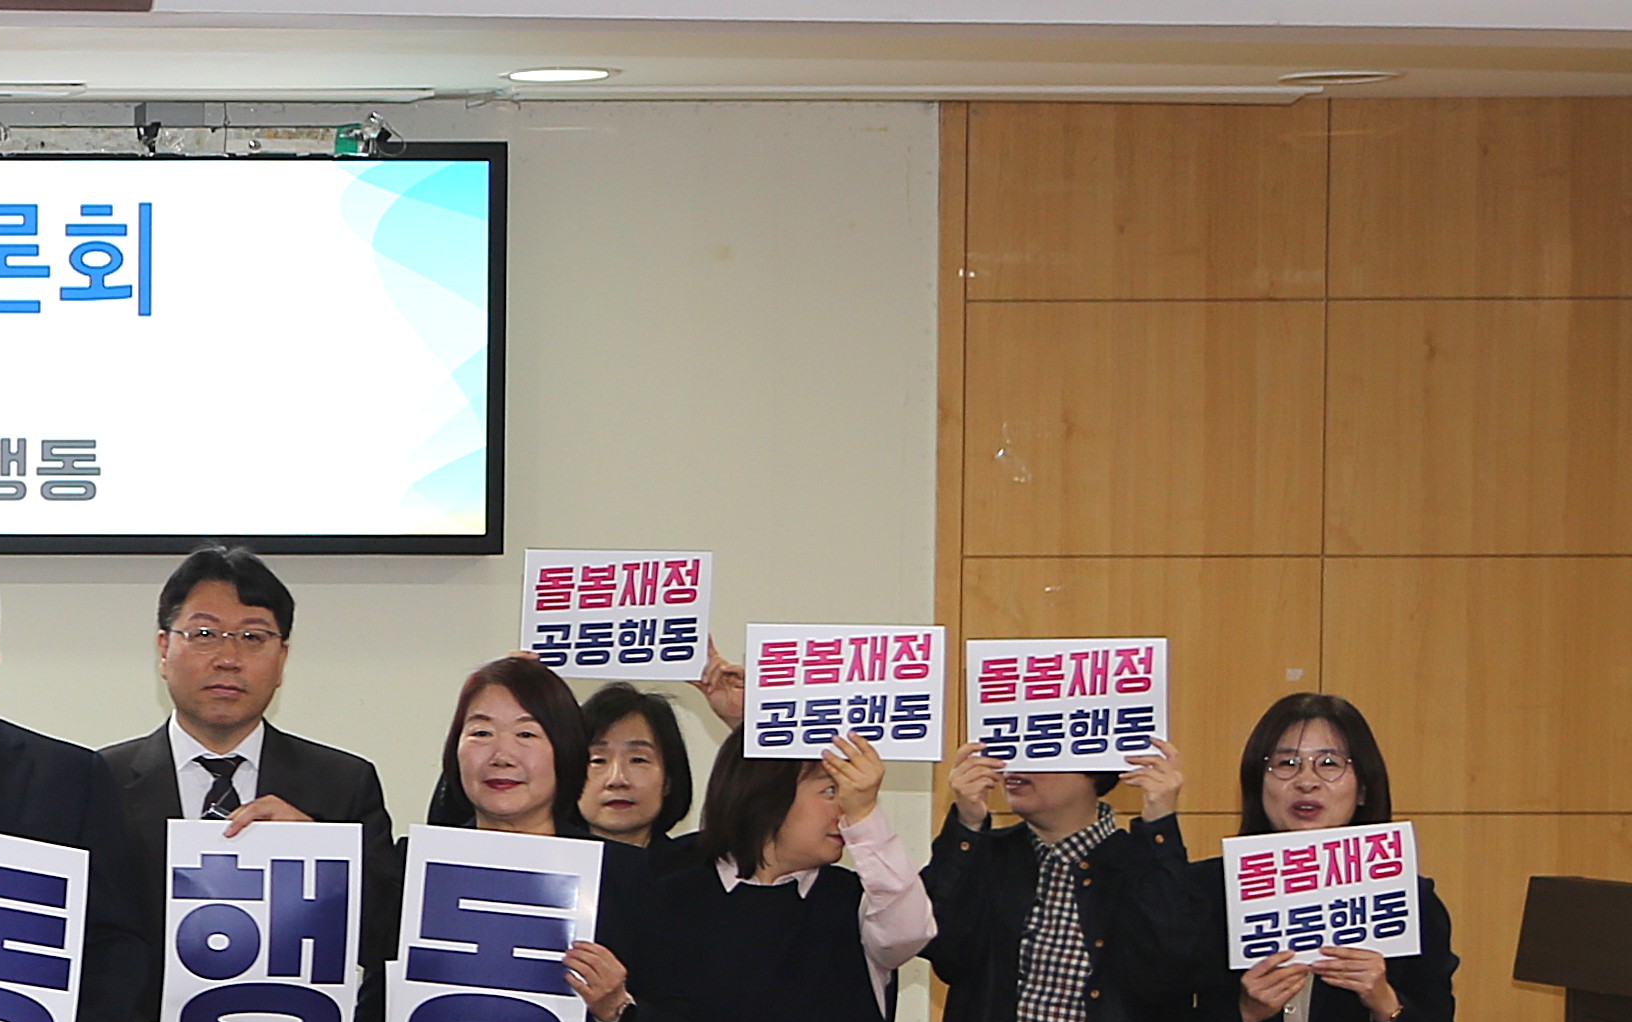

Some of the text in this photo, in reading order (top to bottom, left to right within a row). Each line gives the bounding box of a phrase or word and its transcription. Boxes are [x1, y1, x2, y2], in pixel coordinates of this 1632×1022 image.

[536, 559, 700, 611] 돌봄재정
[532, 617, 699, 667] 공동행동
[757, 633, 932, 688] 돌봄재정
[978, 645, 1154, 704] 돌봄재정
[756, 694, 931, 747] 공동행동
[979, 706, 1155, 760] 공동행동
[1238, 830, 1404, 902] 돌봄재정
[1240, 890, 1410, 960] 공동행동
